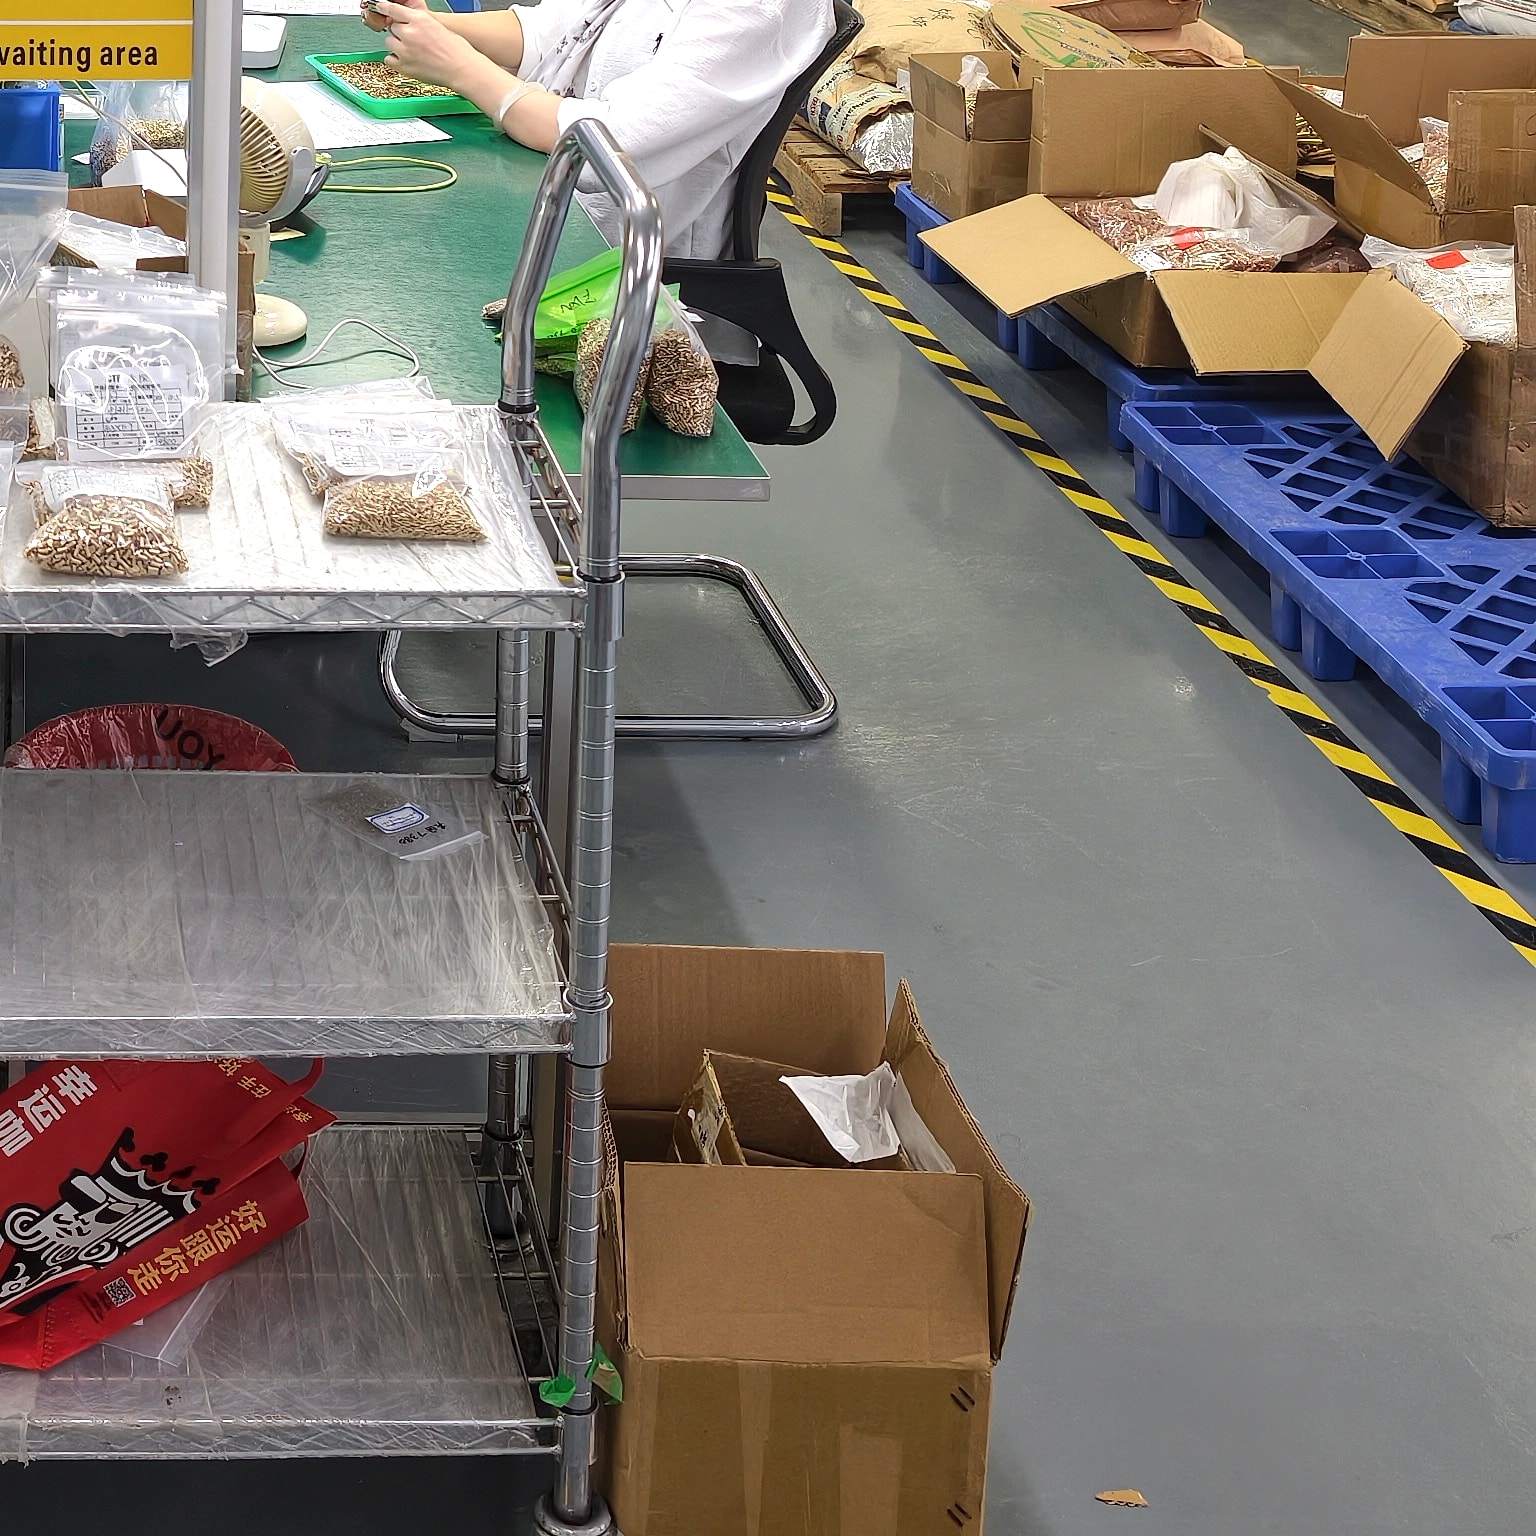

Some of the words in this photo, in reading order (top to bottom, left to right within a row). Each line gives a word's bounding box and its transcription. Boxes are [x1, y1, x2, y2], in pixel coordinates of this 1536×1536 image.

[100, 45, 158, 66] area
[127, 1199, 267, 1296] 好运跟你走
